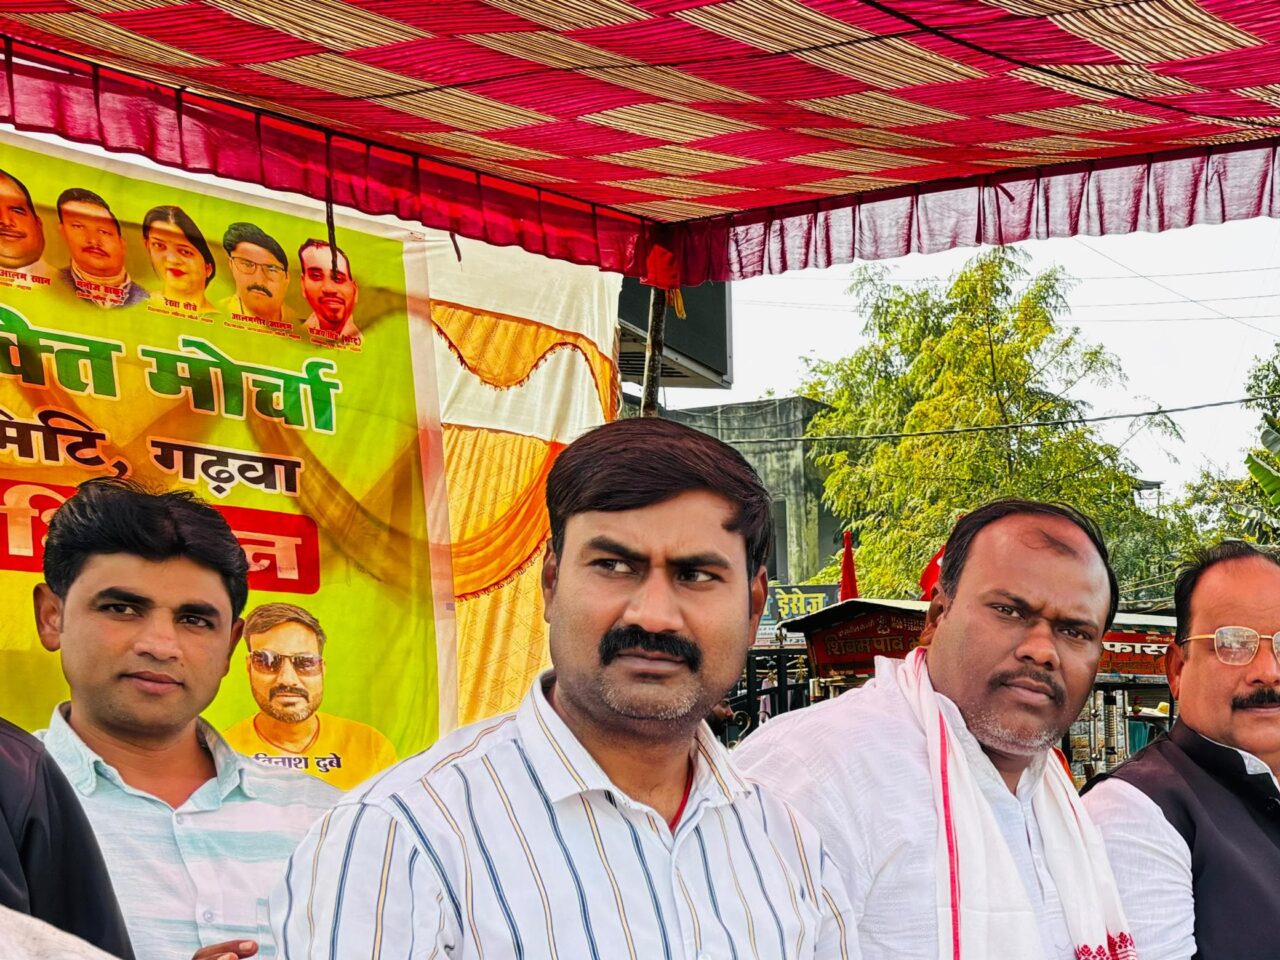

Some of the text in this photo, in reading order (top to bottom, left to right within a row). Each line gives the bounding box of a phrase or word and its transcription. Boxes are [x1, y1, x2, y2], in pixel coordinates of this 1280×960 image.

[141, 338, 340, 432] मोर्चा
[151, 440, 301, 495] गढ़वा
[314, 752, 342, 773] दुबे
